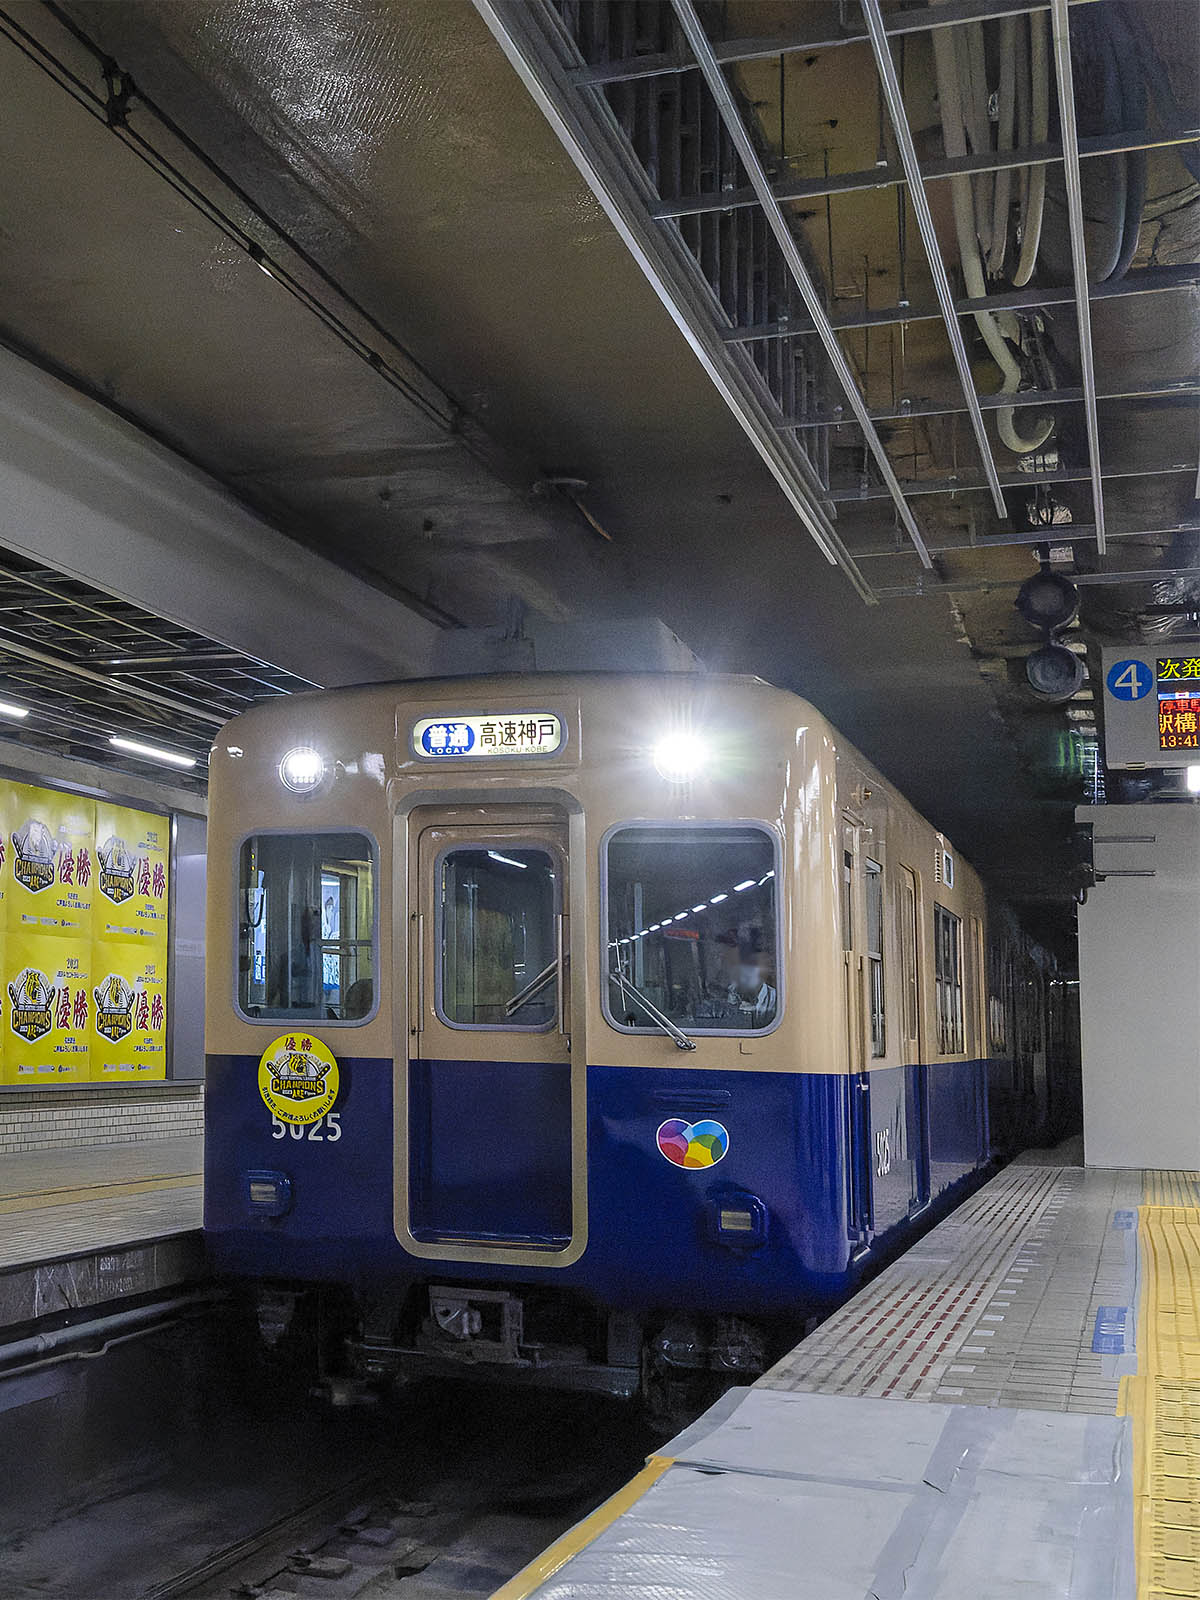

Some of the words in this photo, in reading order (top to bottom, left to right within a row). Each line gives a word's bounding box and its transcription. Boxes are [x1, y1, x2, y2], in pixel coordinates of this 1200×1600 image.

[1114, 663, 1143, 698] 4
[1158, 658, 1200, 679] 次発
[428, 724, 469, 748] 普通
[480, 719, 556, 747] 高速神戸
[1160, 735, 1199, 748] 13:41
[429, 746, 467, 755] LOCAL
[57, 843, 90, 886] 優勝
[136, 857, 164, 898] 優勝
[54, 986, 87, 1029] 優勝
[134, 990, 163, 1030] 優勝
[271, 1078, 325, 1095] CHAMPIONS
[271, 1112, 342, 1142] 5025
